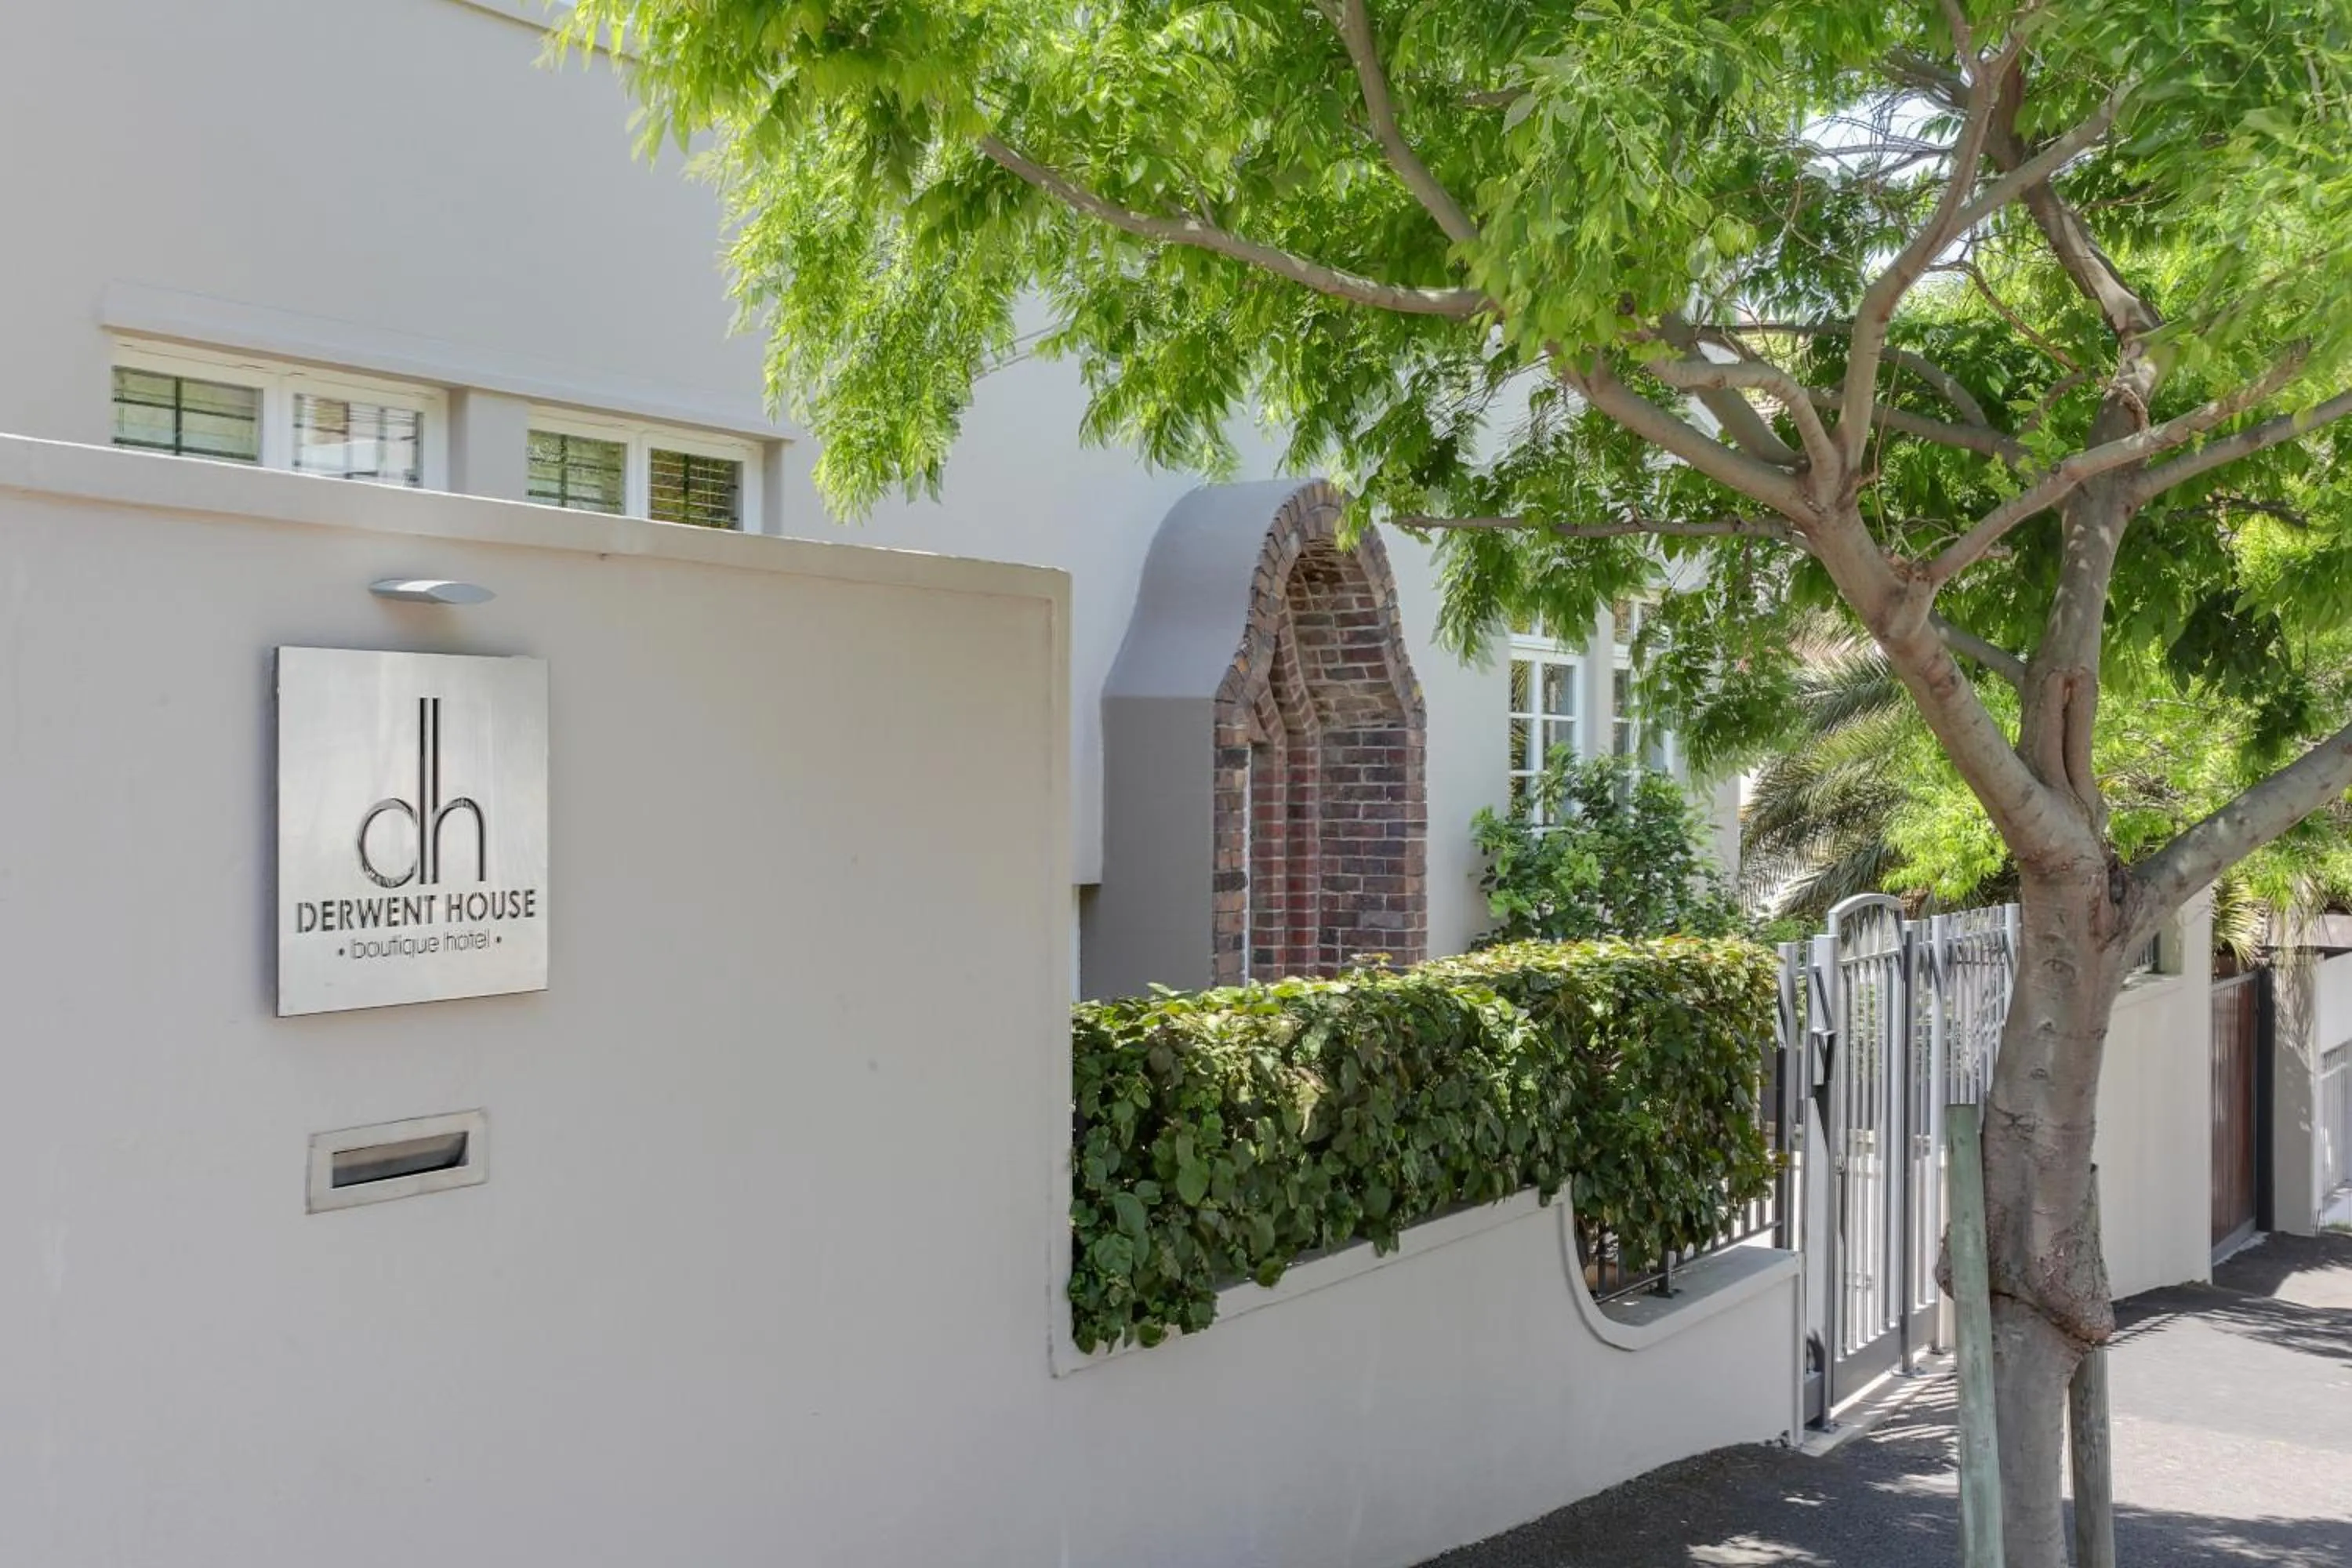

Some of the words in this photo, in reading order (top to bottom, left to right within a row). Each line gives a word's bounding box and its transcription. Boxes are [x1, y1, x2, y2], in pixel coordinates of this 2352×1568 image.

[296, 895, 437, 934] DERWENT
[445, 889, 537, 923] HOUSE
[351, 934, 439, 960] boutique
[444, 929, 490, 953] hotel
